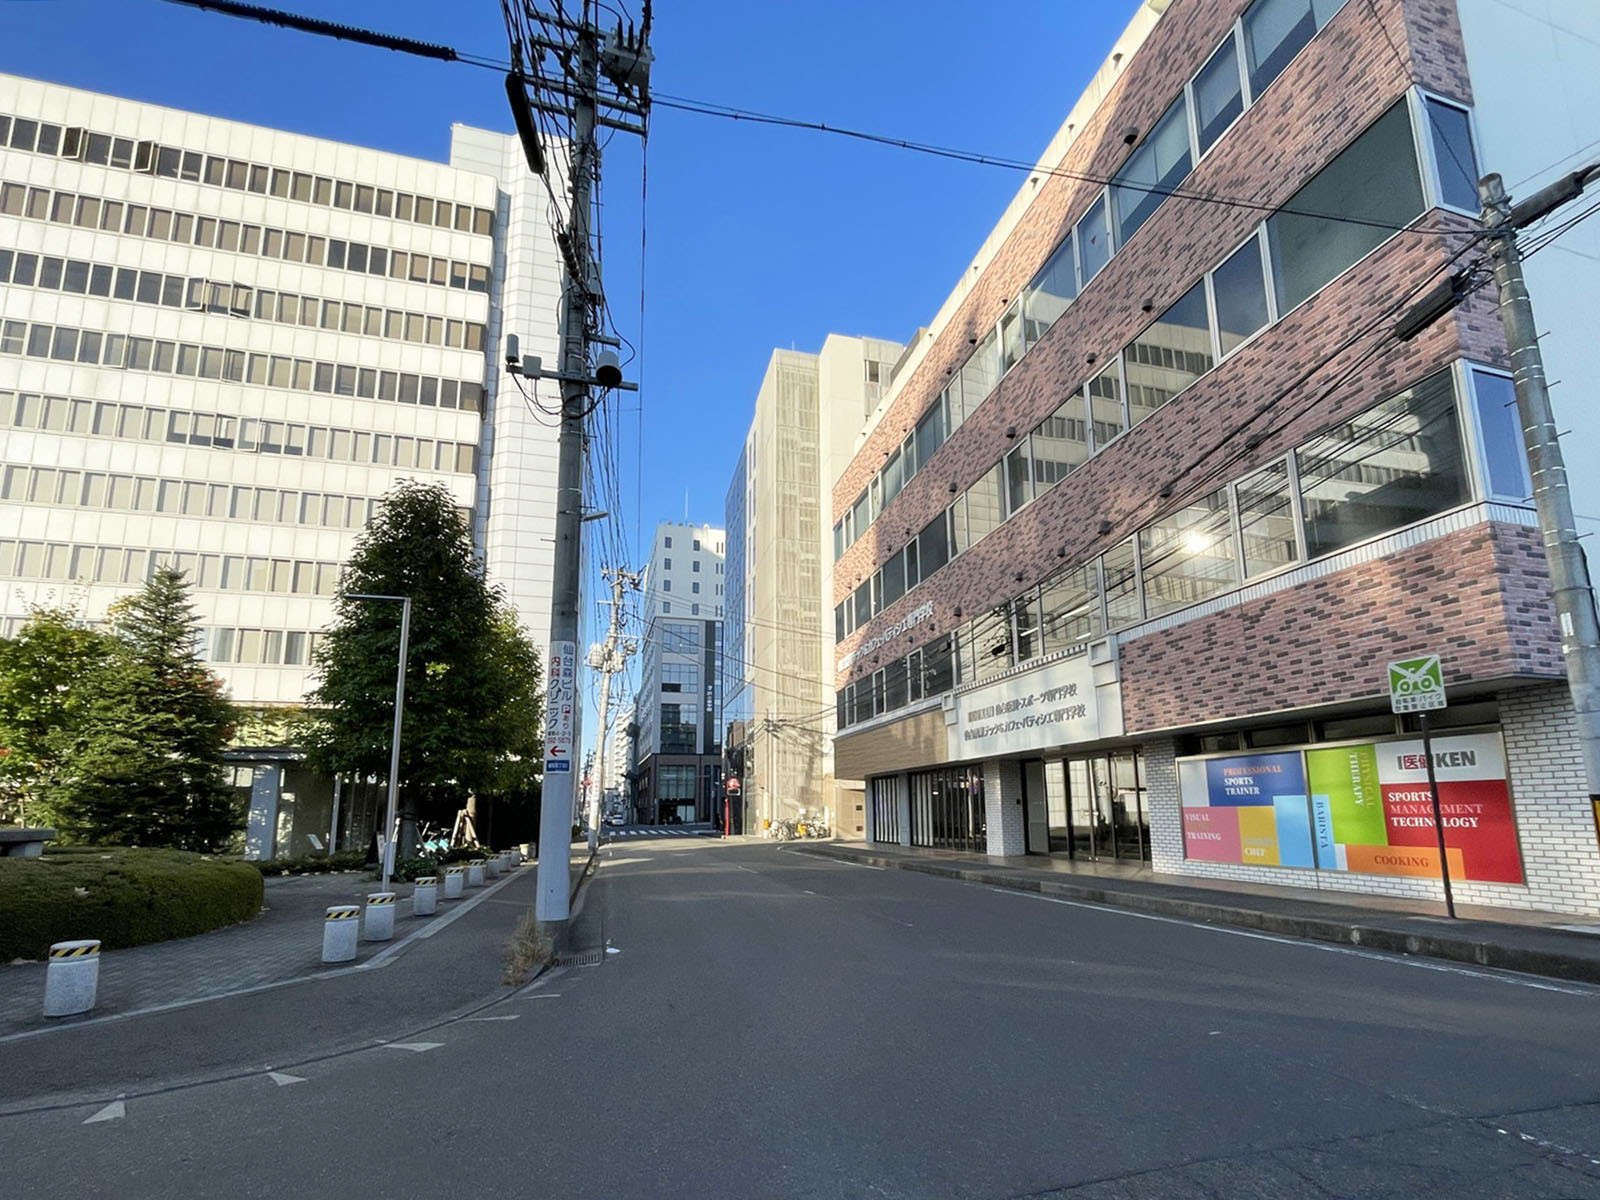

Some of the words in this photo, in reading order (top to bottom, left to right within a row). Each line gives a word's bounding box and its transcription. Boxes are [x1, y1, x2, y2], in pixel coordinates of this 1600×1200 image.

[1223, 765, 1283, 776] PROFESSIONAL
[1224, 777, 1254, 786] SPORTS
[1349, 754, 1364, 806] THERAPY
[1360, 752, 1375, 808] PHYSICAL
[1225, 787, 1260, 796] TRAINER
[1390, 803, 1483, 815] MANAGMENT
[1185, 813, 1210, 822] VISUAL
[1391, 816, 1479, 828] TECHNLOGY
[1316, 801, 1329, 849] BARISTA
[1187, 832, 1222, 841] TRAINING
[1244, 847, 1266, 857] CHEF
[1374, 854, 1429, 867] COOKING
